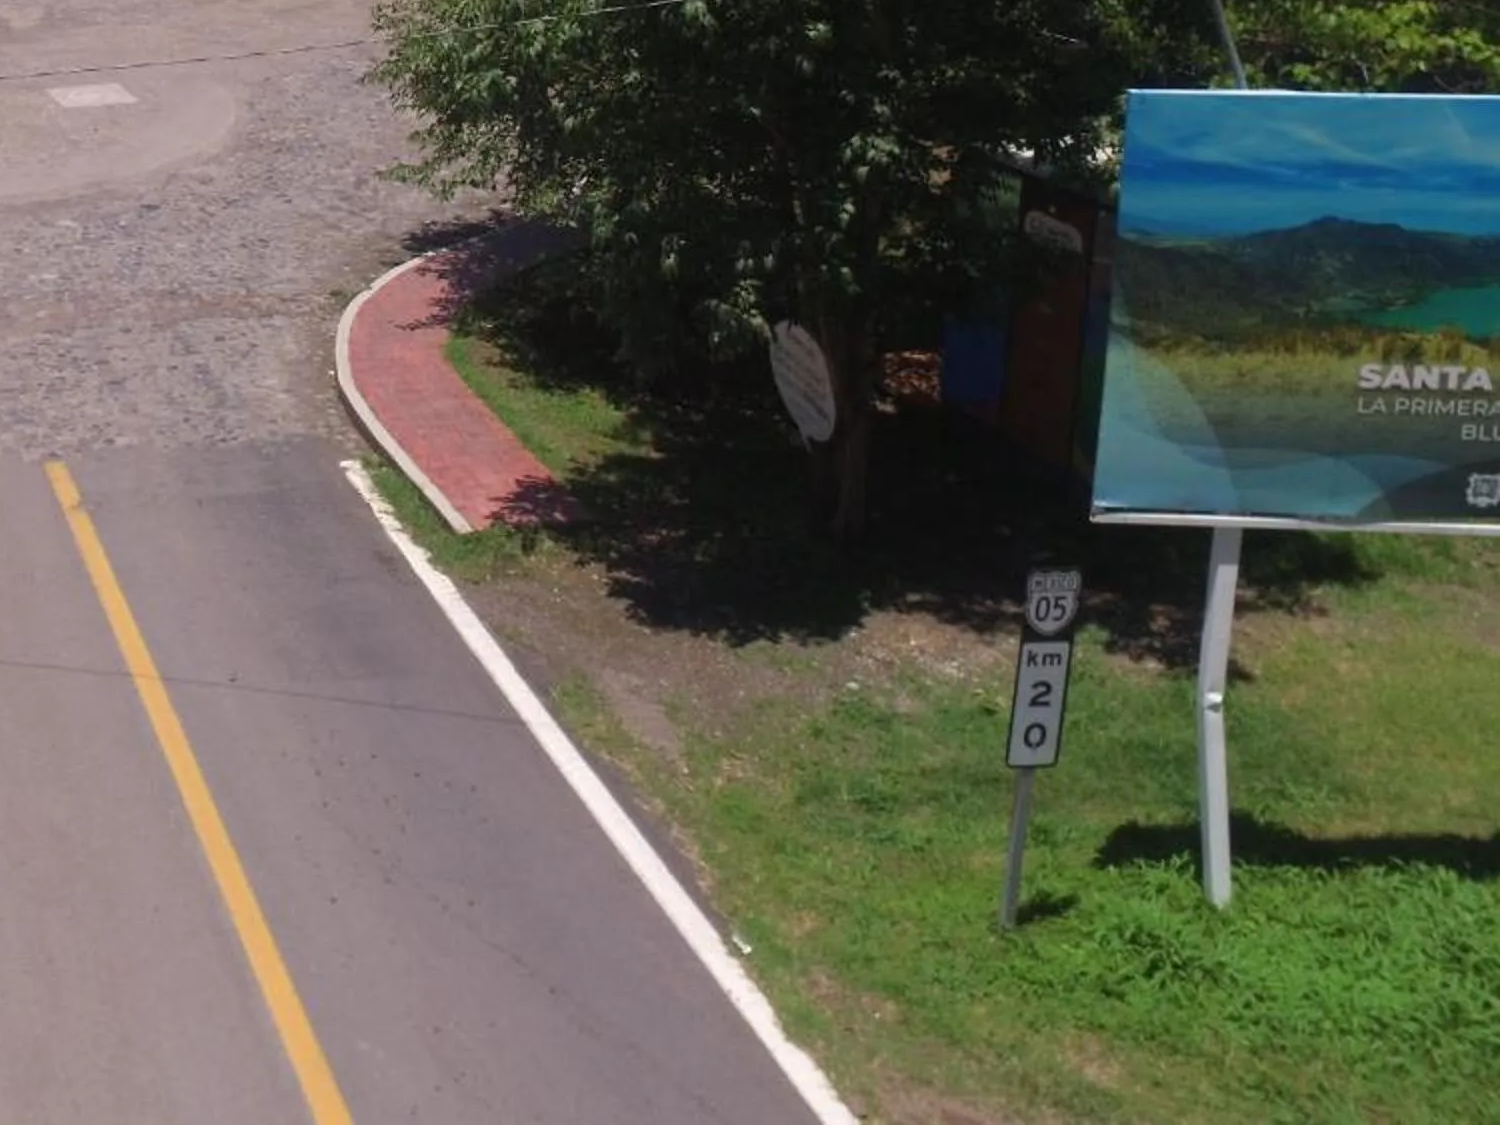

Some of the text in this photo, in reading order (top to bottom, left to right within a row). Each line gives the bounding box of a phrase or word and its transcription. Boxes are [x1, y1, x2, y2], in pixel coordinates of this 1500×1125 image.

[1357, 363, 1493, 391] SANTA
[1357, 396, 1387, 414] LA
[1035, 596, 1067, 622] 05
[1026, 650, 1062, 668] km
